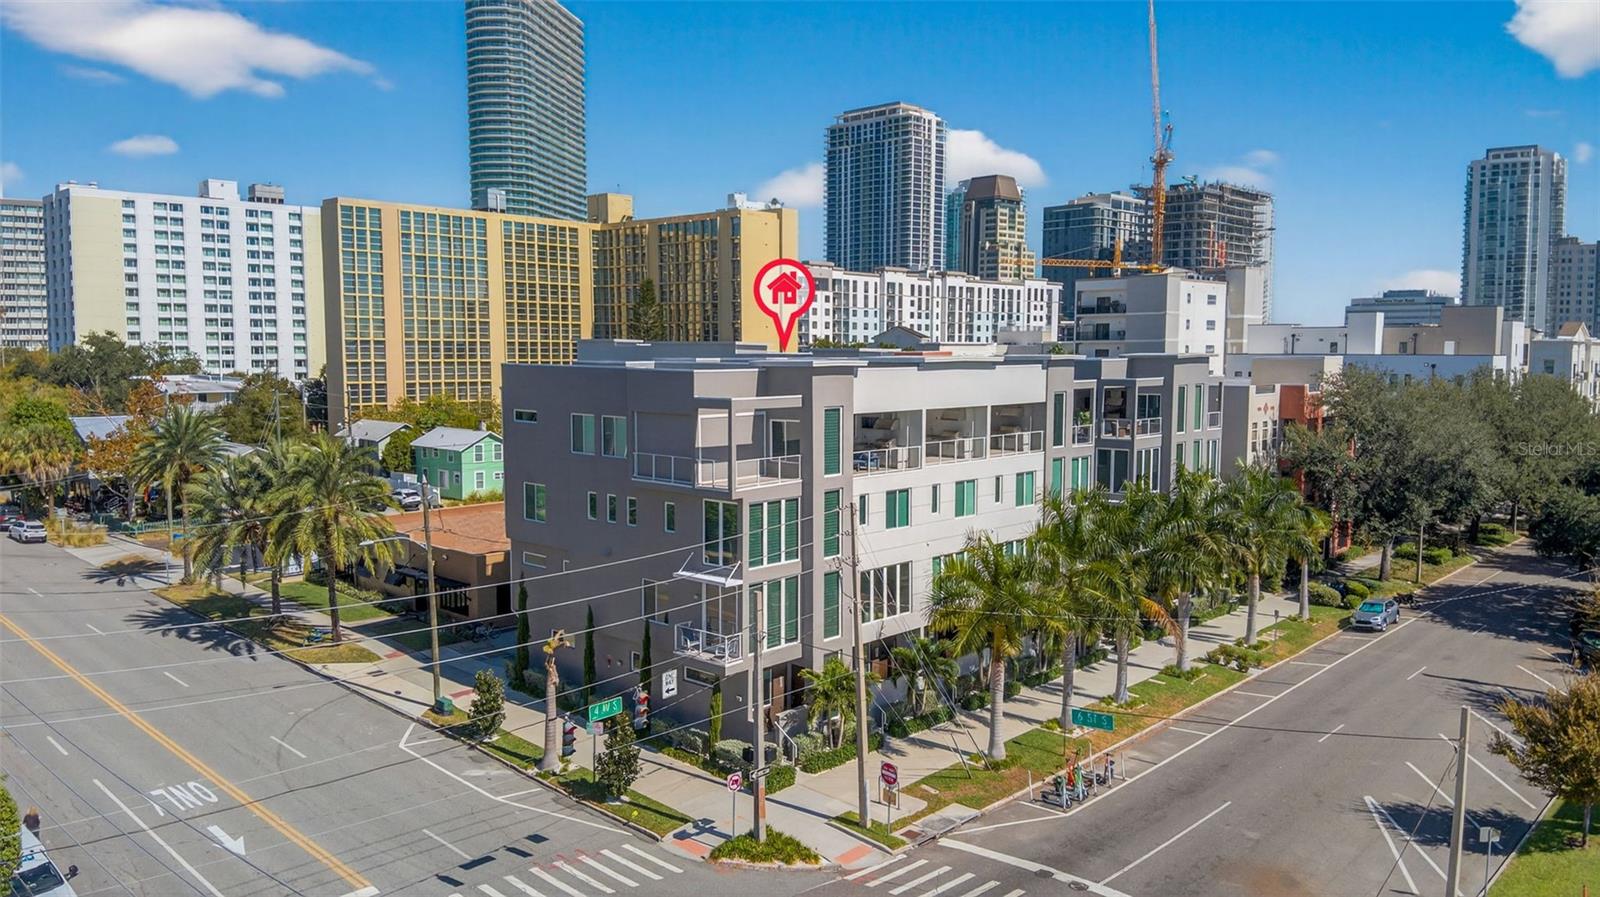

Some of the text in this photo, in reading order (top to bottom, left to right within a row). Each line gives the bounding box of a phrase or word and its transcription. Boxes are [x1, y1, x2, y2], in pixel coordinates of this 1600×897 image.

[593, 706, 599, 717] 4
[612, 700, 619, 712] S
[1077, 711, 1083, 721] 6
[1101, 715, 1108, 725] S
[143, 781, 218, 816] ONLY
